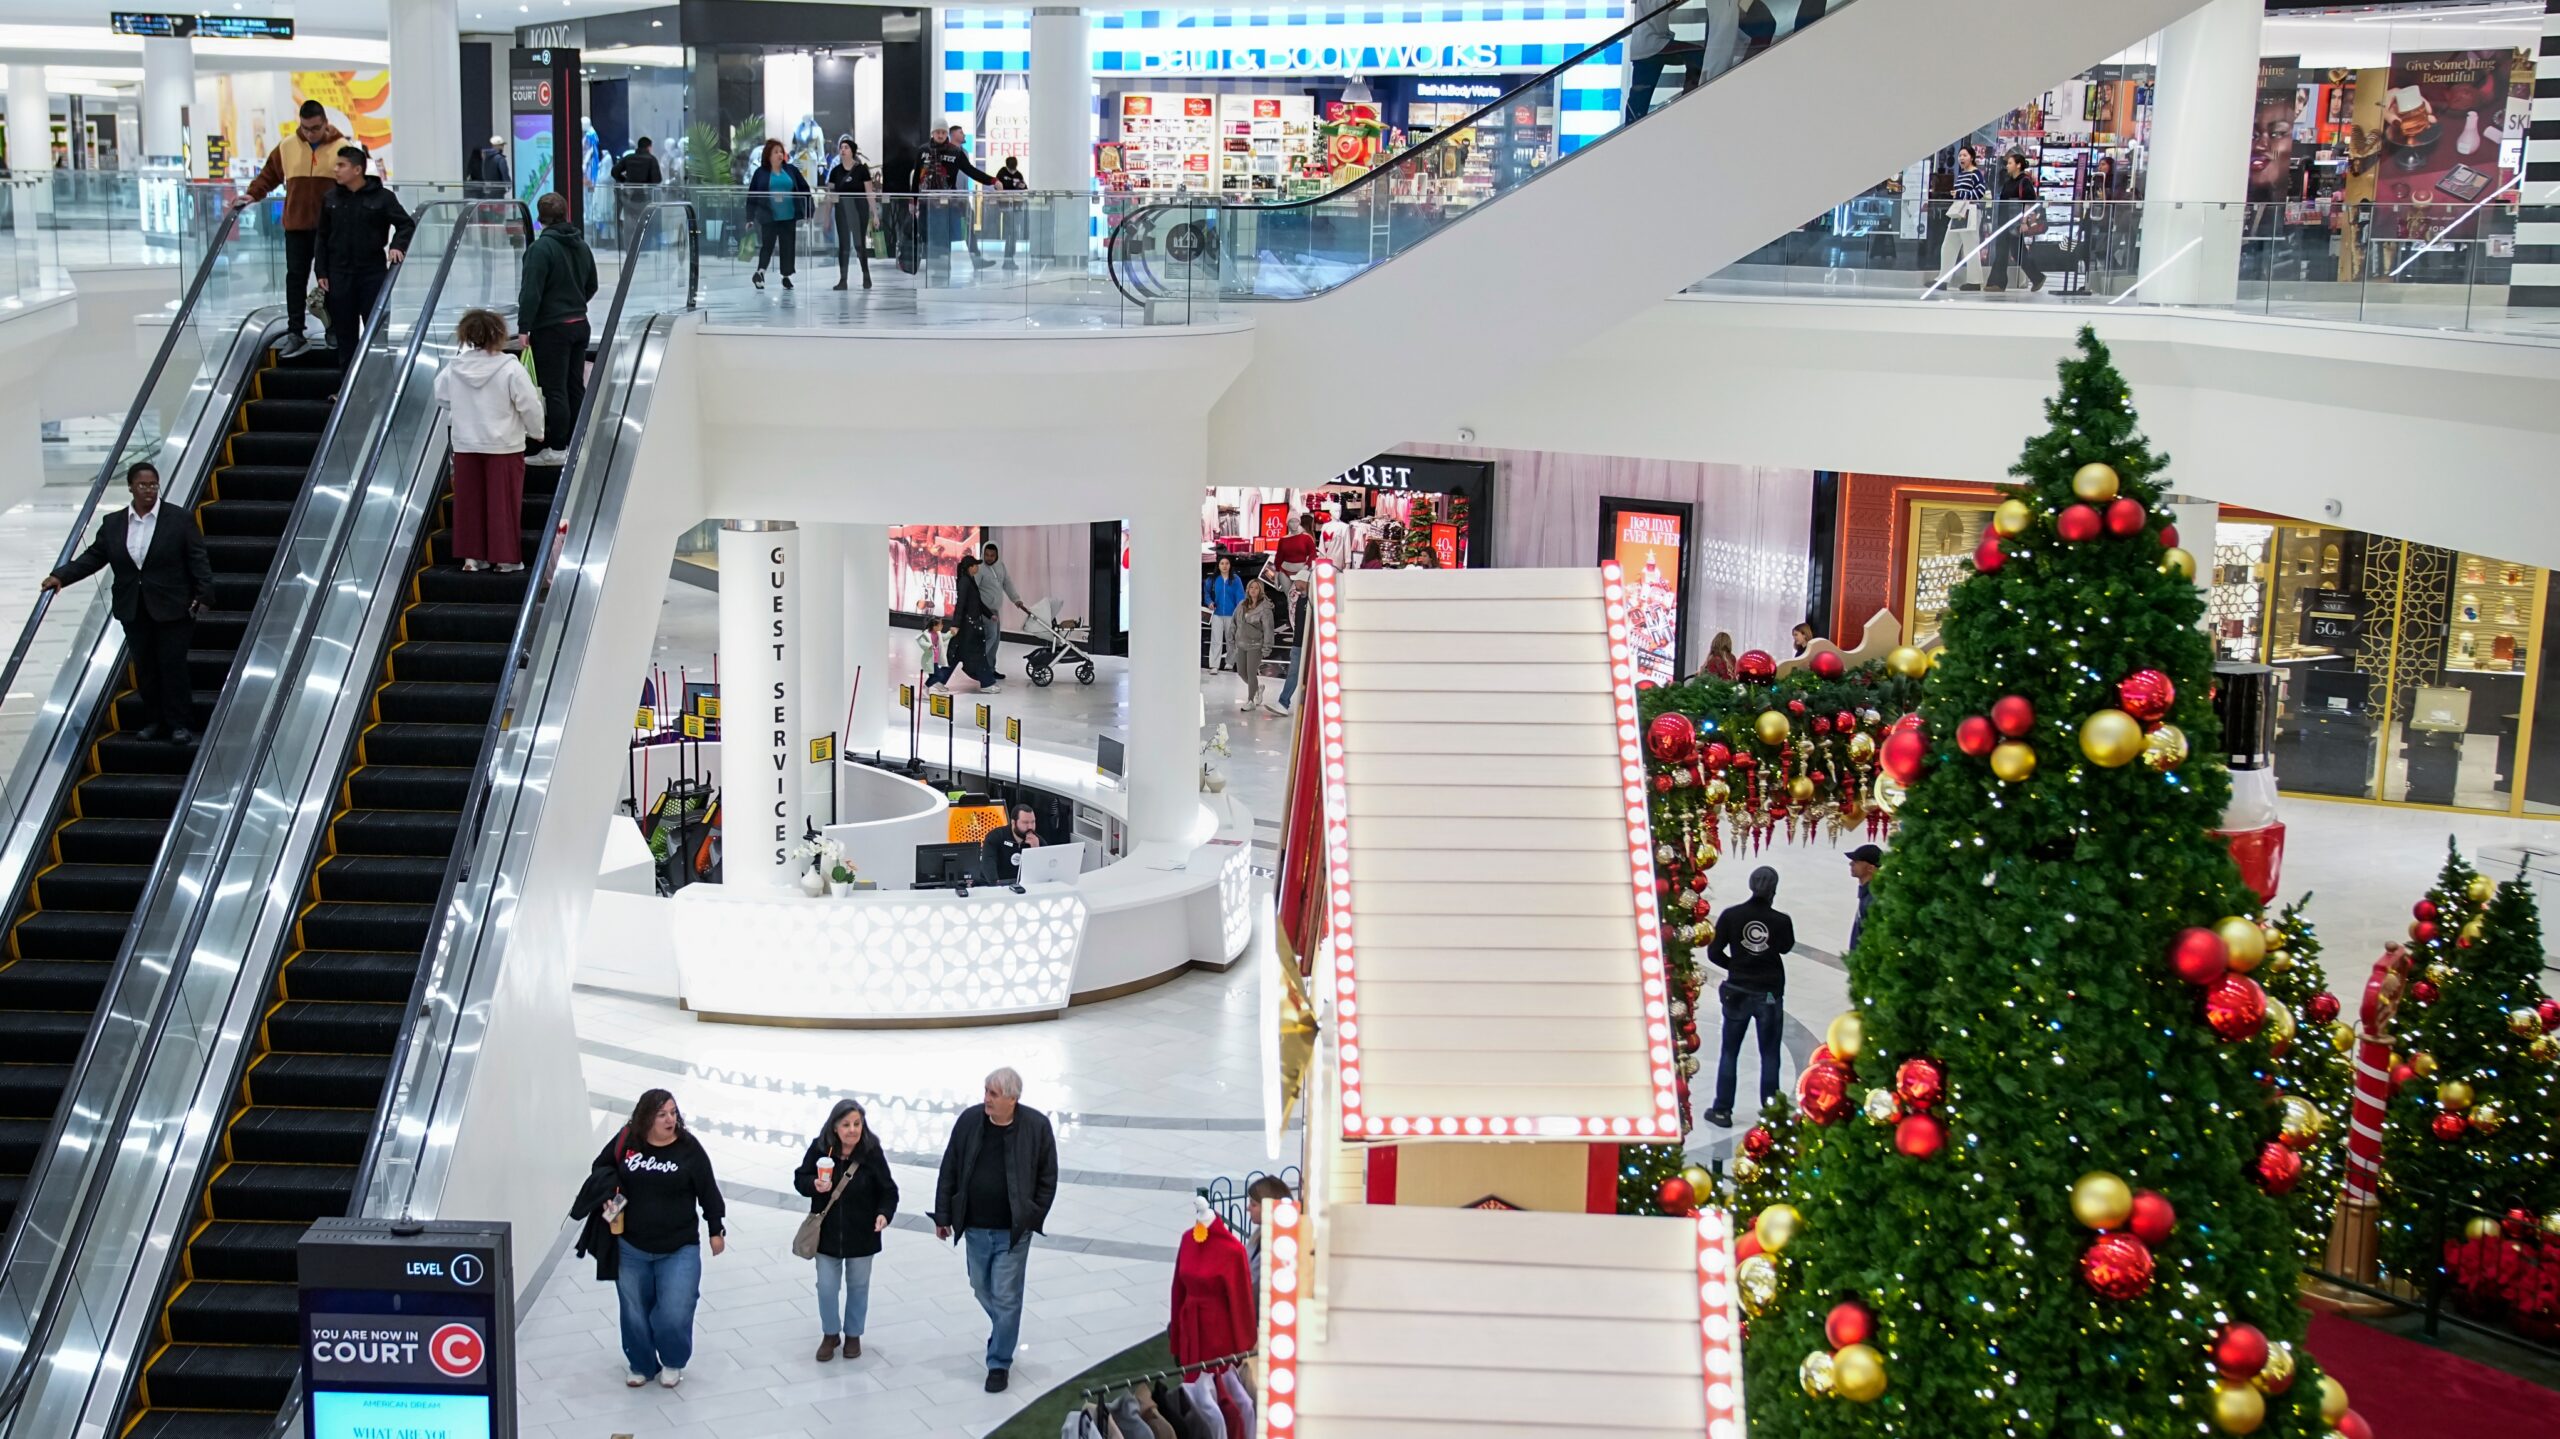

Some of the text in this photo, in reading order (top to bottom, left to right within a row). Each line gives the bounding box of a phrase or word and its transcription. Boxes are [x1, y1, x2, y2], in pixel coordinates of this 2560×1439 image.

[1229, 46, 1260, 73] &
[1264, 45, 1363, 79] Body
[1373, 43, 1497, 70] Works
[2405, 59, 2497, 71] Give Something
[2423, 71, 2475, 83] Beautiful
[512, 91, 537, 101] COURT
[990, 128, 1021, 140] GET
[1330, 464, 1411, 488] CRET
[1630, 515, 1675, 532] HOLIDAY
[1623, 528, 1680, 547] EVER AFTER
[770, 546, 787, 866] GUEST SERVICES
[627, 1152, 679, 1173] Believe
[406, 1260, 471, 1280] LEVEL 1
[313, 1329, 419, 1341] YOU ARE NOW IN
[312, 1334, 472, 1367] COURT C
[362, 1400, 441, 1409] AMERICAN DREAM
[353, 1427, 450, 1439] WHAT ARE YOU
